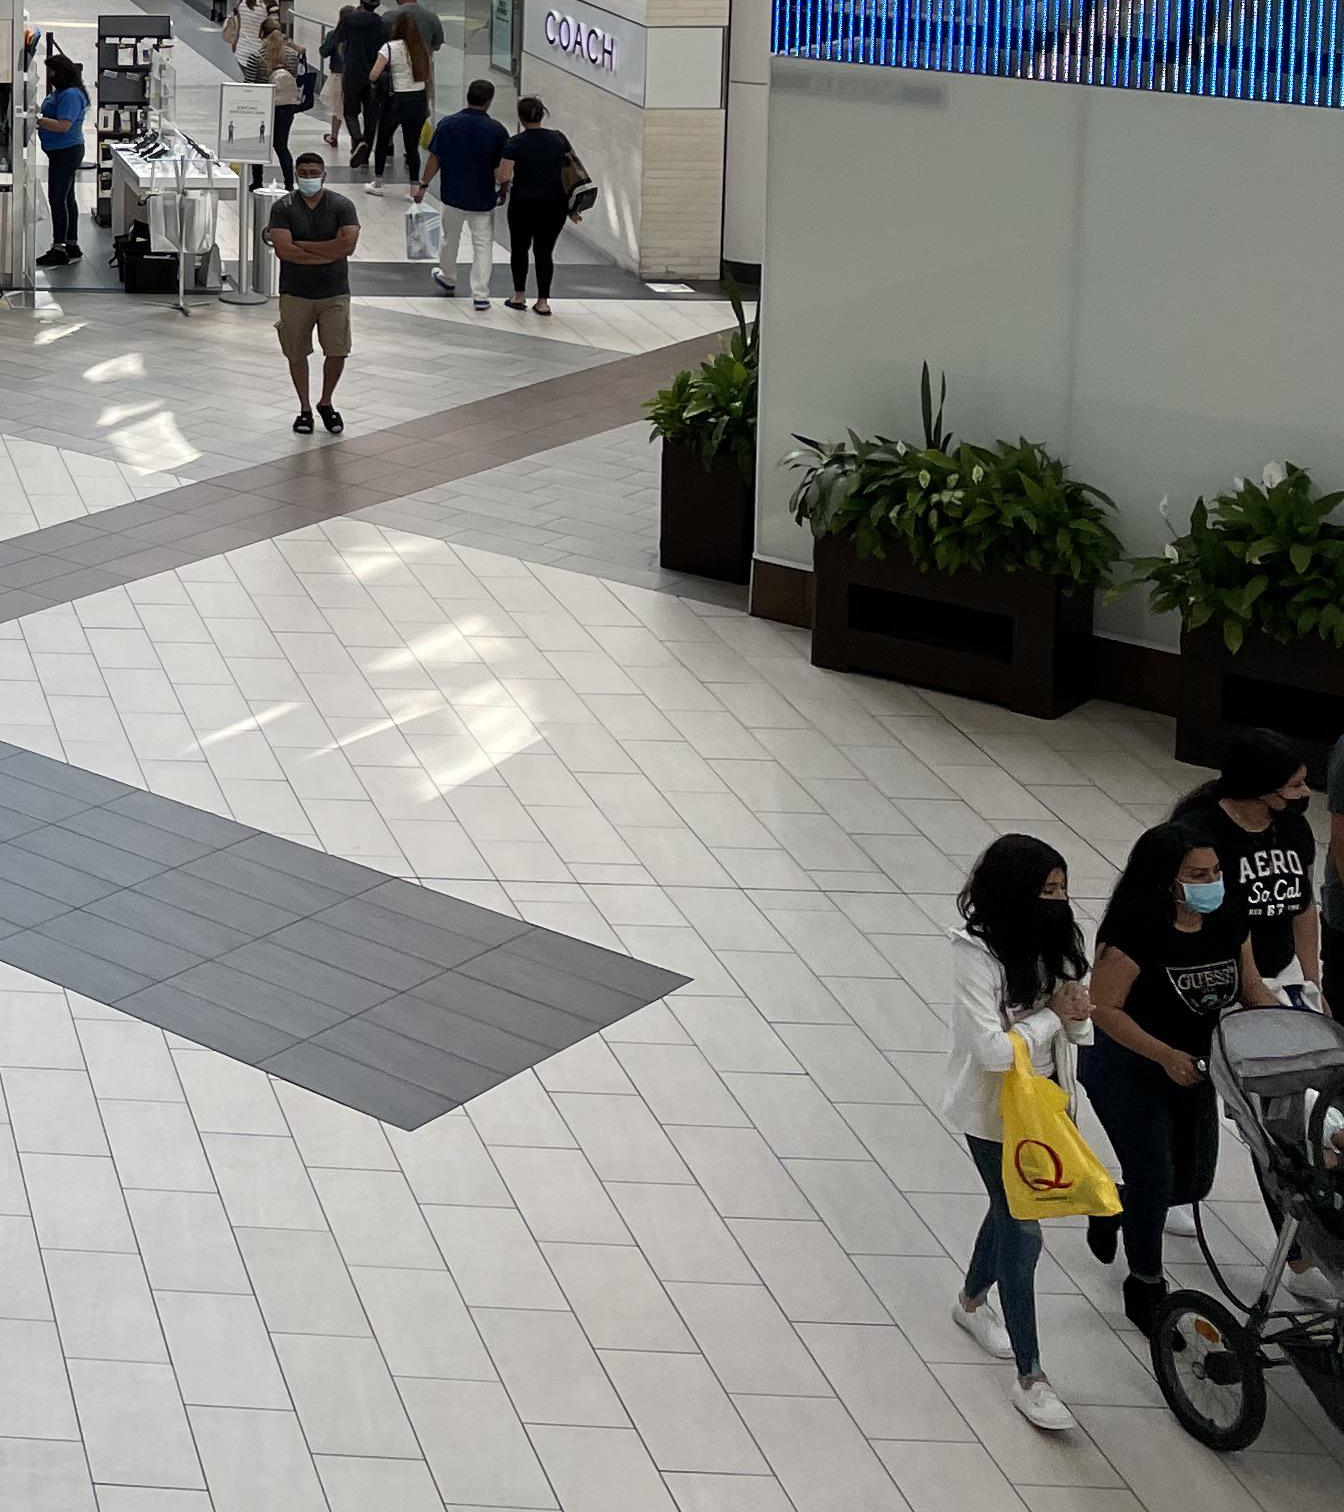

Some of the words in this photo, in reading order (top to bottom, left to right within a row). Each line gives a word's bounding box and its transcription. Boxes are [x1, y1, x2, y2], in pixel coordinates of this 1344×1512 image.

[544, 10, 617, 72] COACH
[1238, 849, 1304, 884] AERO
[1274, 877, 1302, 901] Cal
[1014, 1139, 1074, 1191] Q
